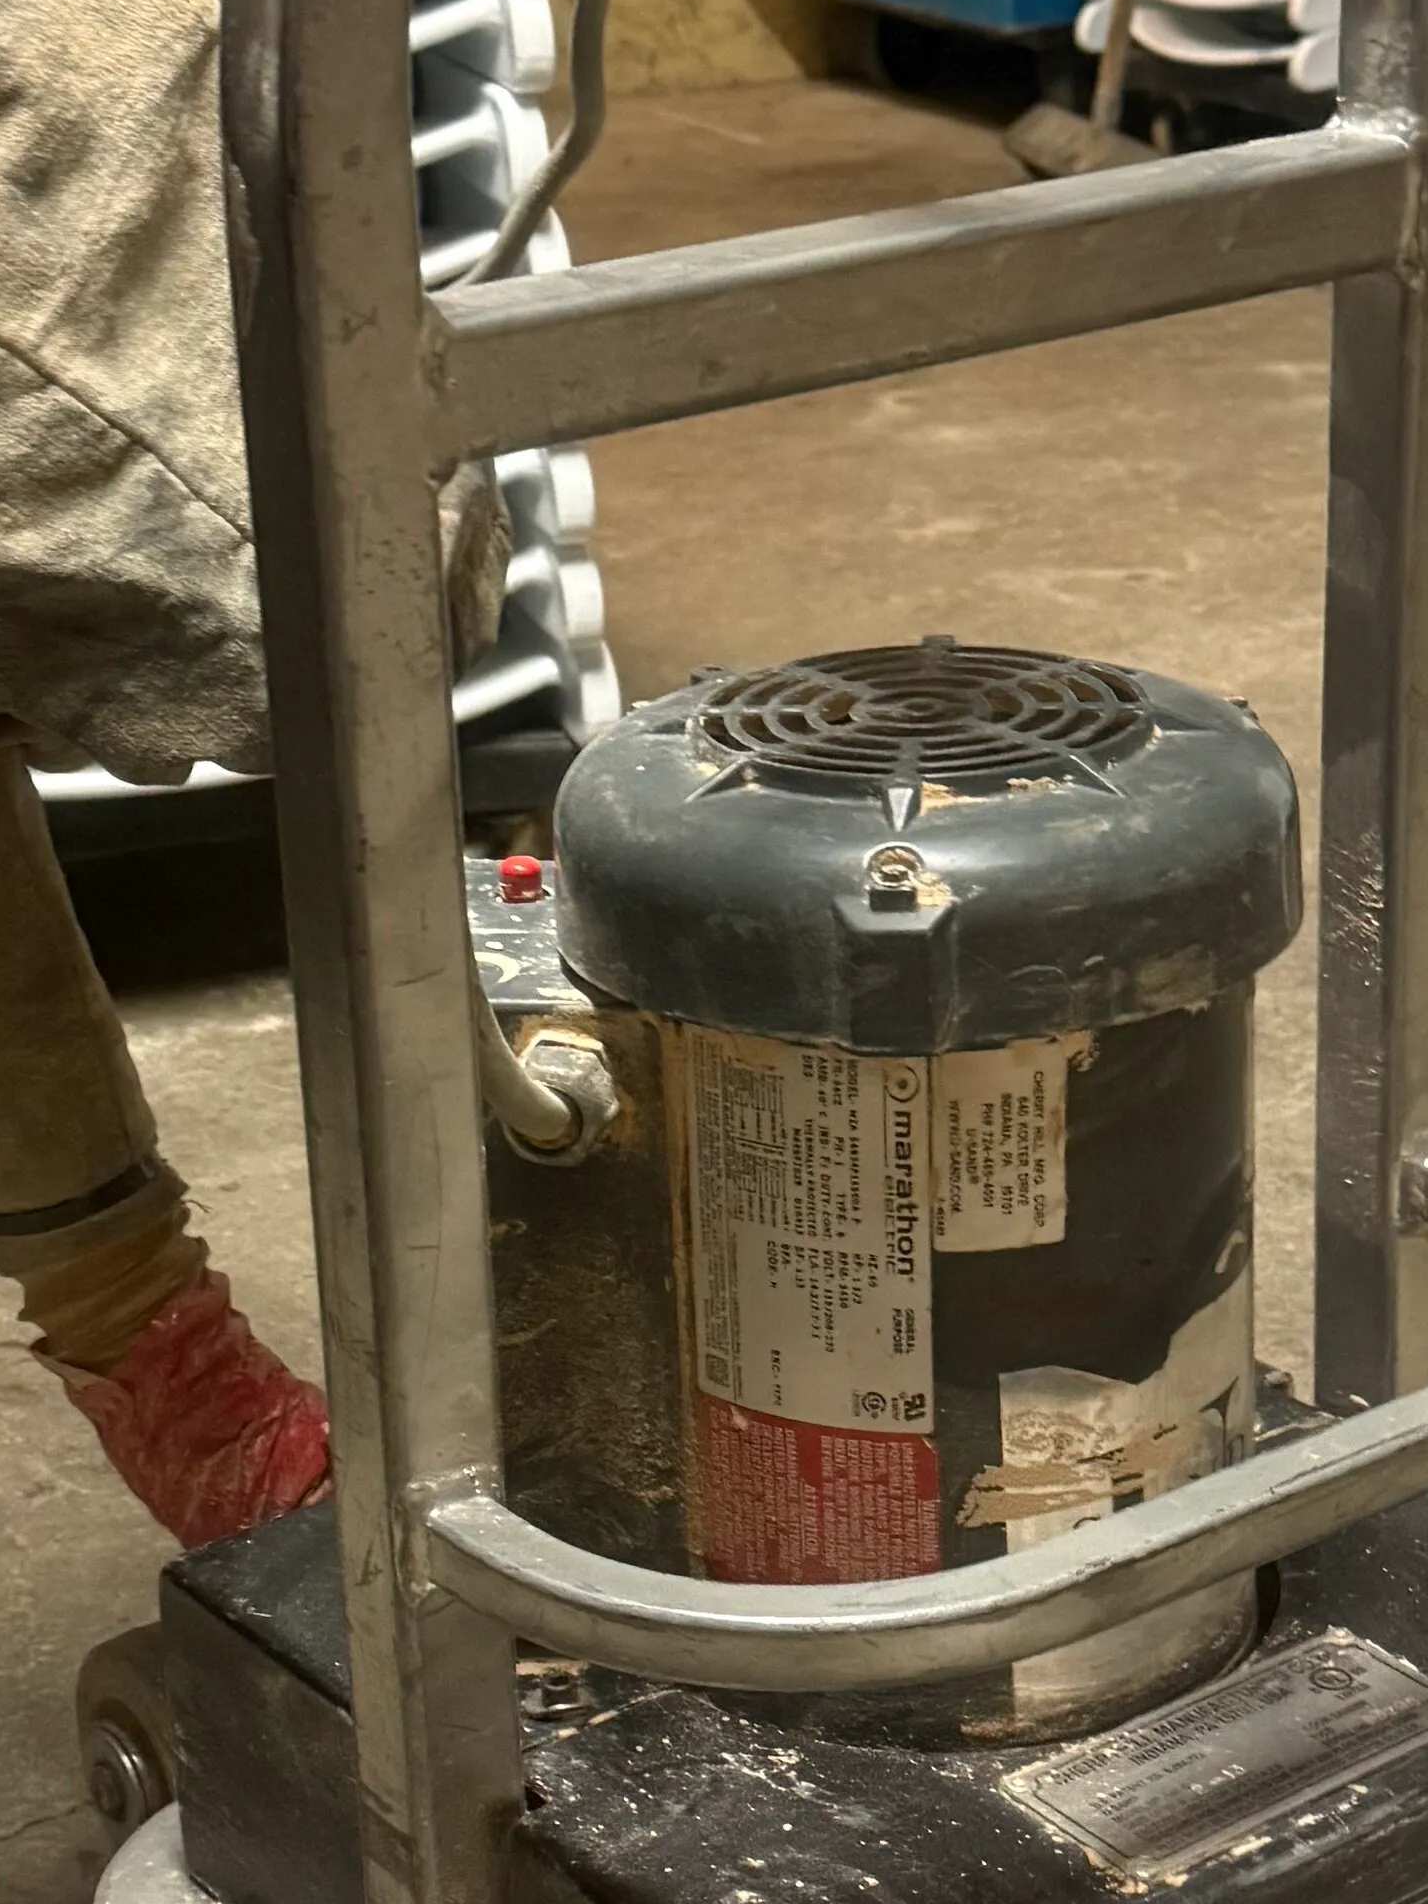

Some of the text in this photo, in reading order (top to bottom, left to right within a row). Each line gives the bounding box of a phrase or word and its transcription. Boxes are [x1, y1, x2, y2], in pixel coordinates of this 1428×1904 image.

[1032, 1070, 1046, 1120] CHERRY
[1000, 1151, 1014, 1168] PA
[893, 1109, 920, 1276] marathon
[1016, 1172, 1030, 1207] DRIVE
[891, 1306, 903, 1356] PURPOSE
[904, 1307, 916, 1355] GENERAL
[804, 1483, 819, 1557] ATTENTION
[922, 1498, 938, 1563] WARNING
